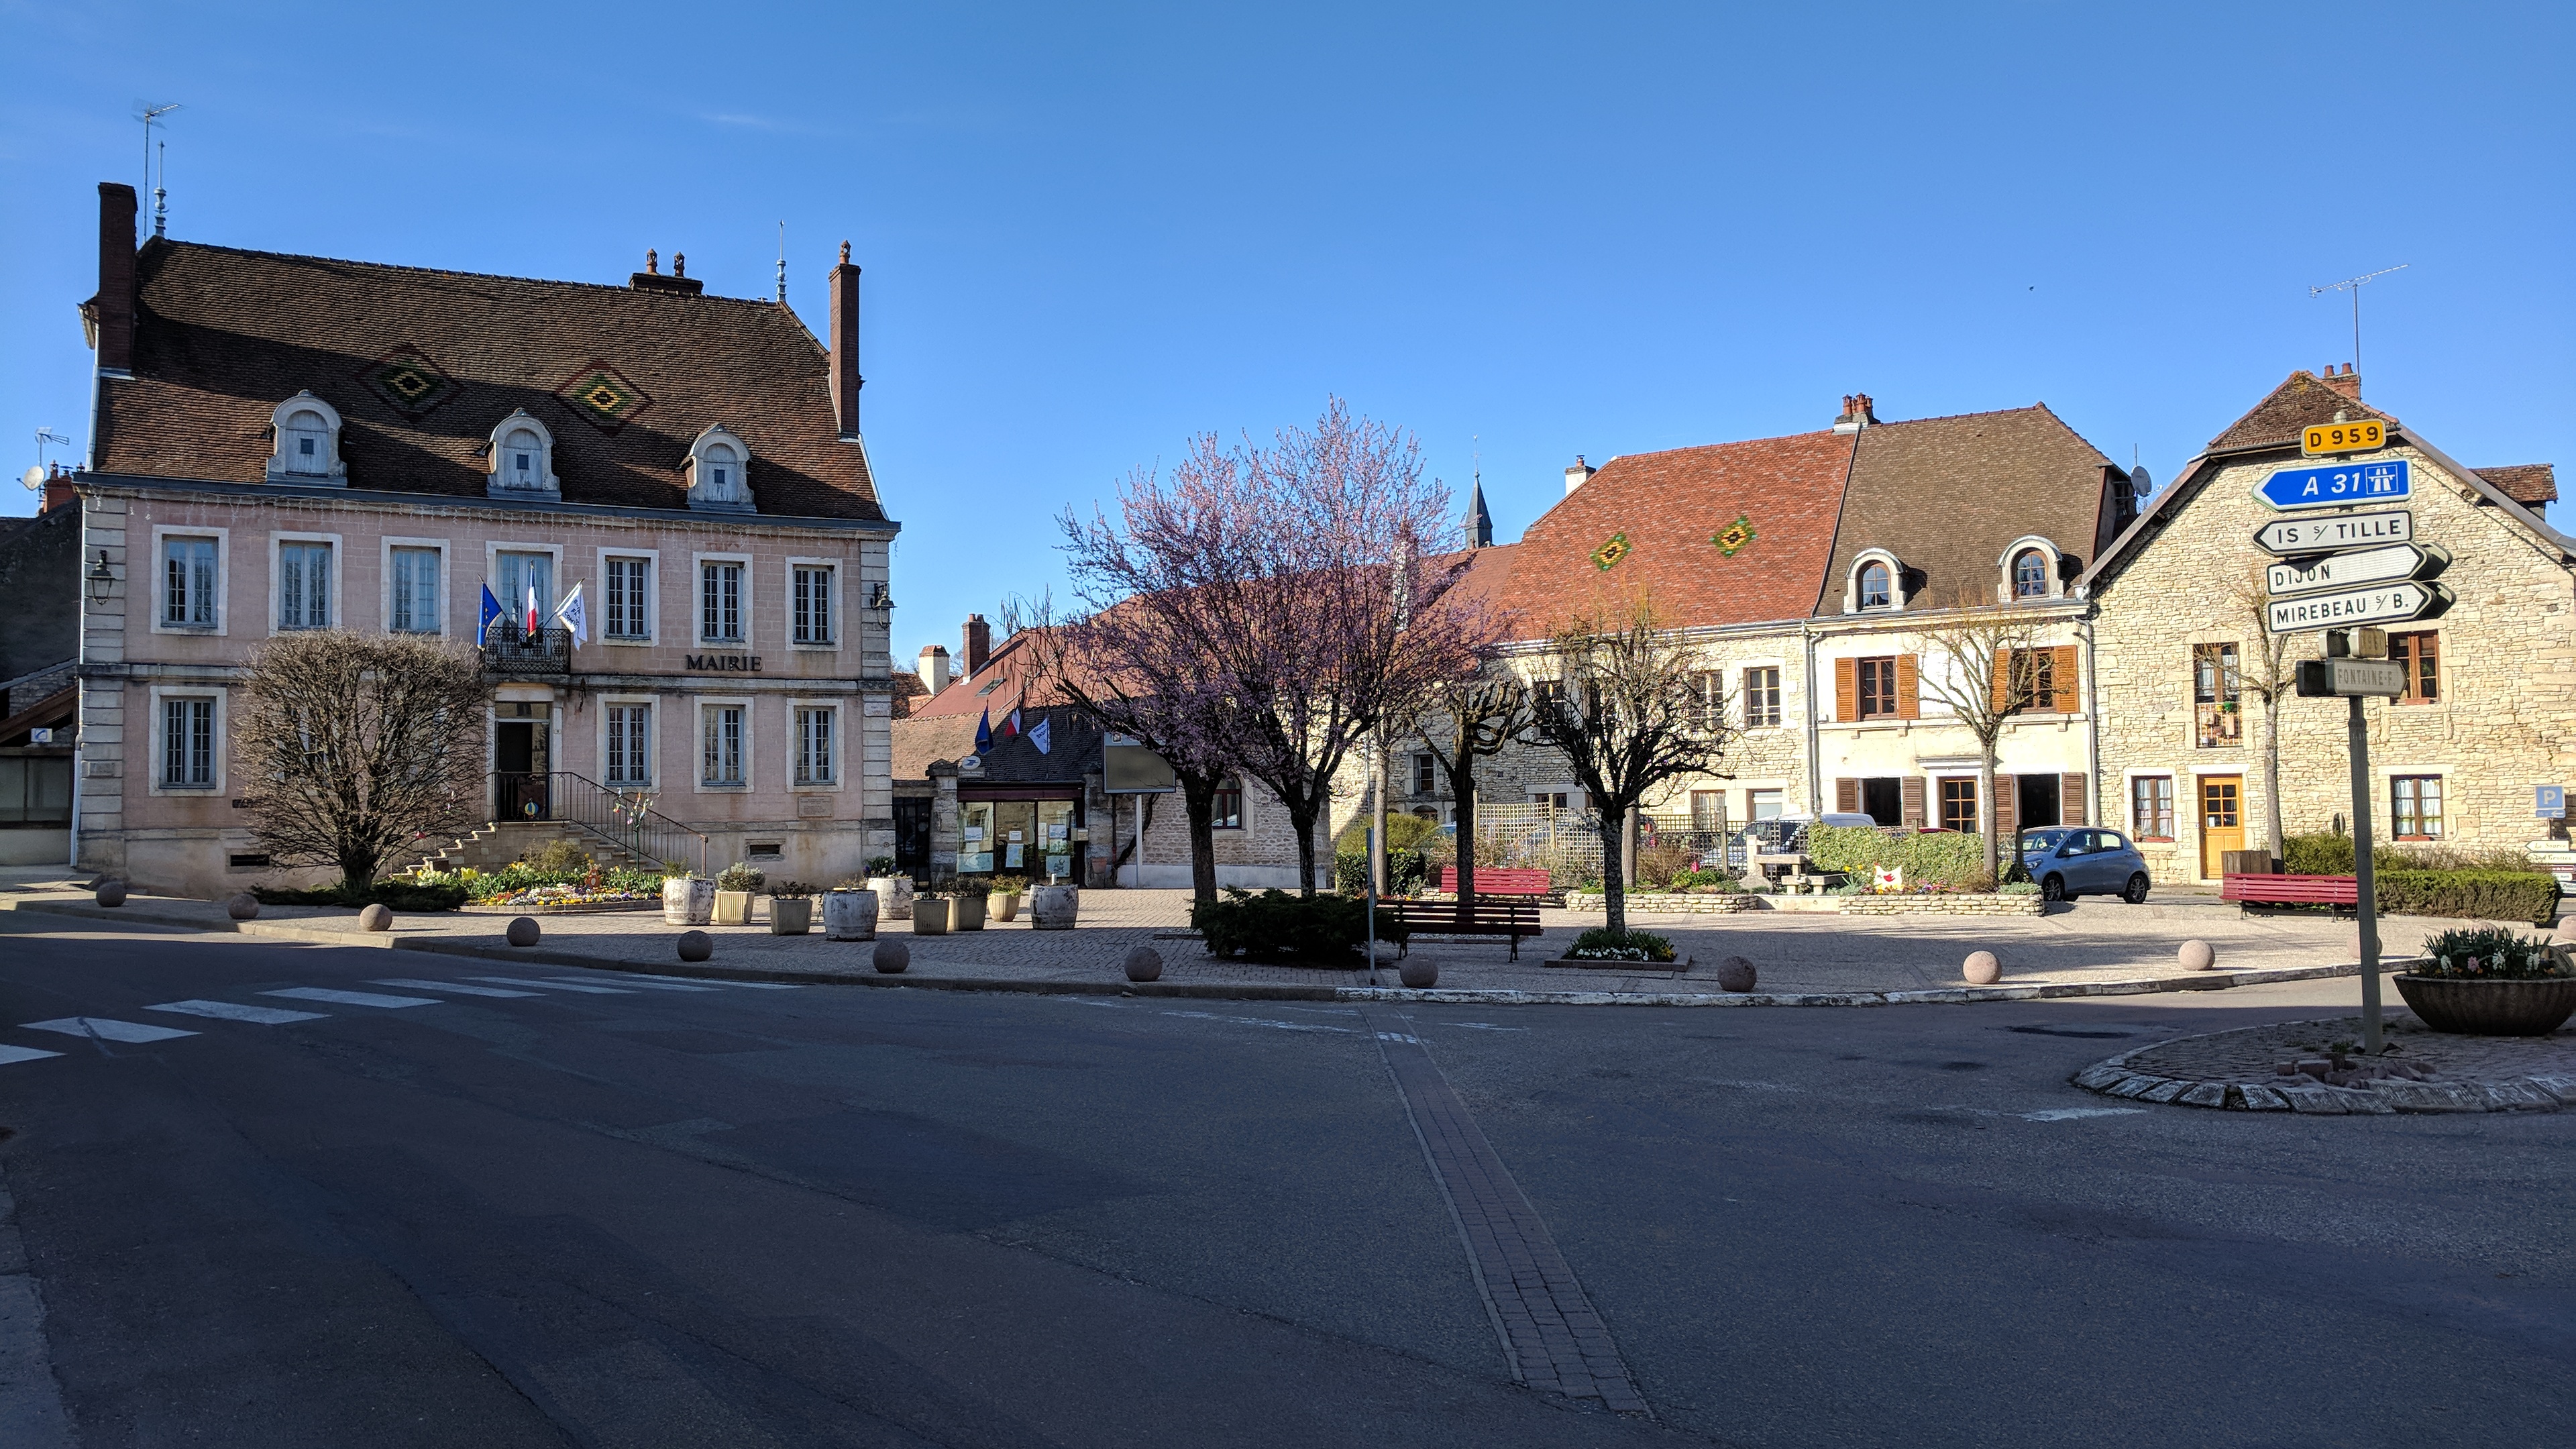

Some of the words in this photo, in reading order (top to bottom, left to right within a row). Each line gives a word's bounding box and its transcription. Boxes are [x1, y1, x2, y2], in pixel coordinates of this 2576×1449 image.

[2310, 433, 2321, 447] D
[2331, 427, 2378, 445] 959
[2302, 476, 2318, 496] A
[2331, 472, 2360, 494] 31
[2277, 528, 2299, 544] IS
[2336, 519, 2402, 539] TILLE
[2275, 564, 2330, 587] DIJON
[2276, 597, 2367, 625] MIREBEAU
[2393, 593, 2409, 609] B.
[686, 654, 763, 672] MAIRIE
[2543, 790, 2556, 805] P
